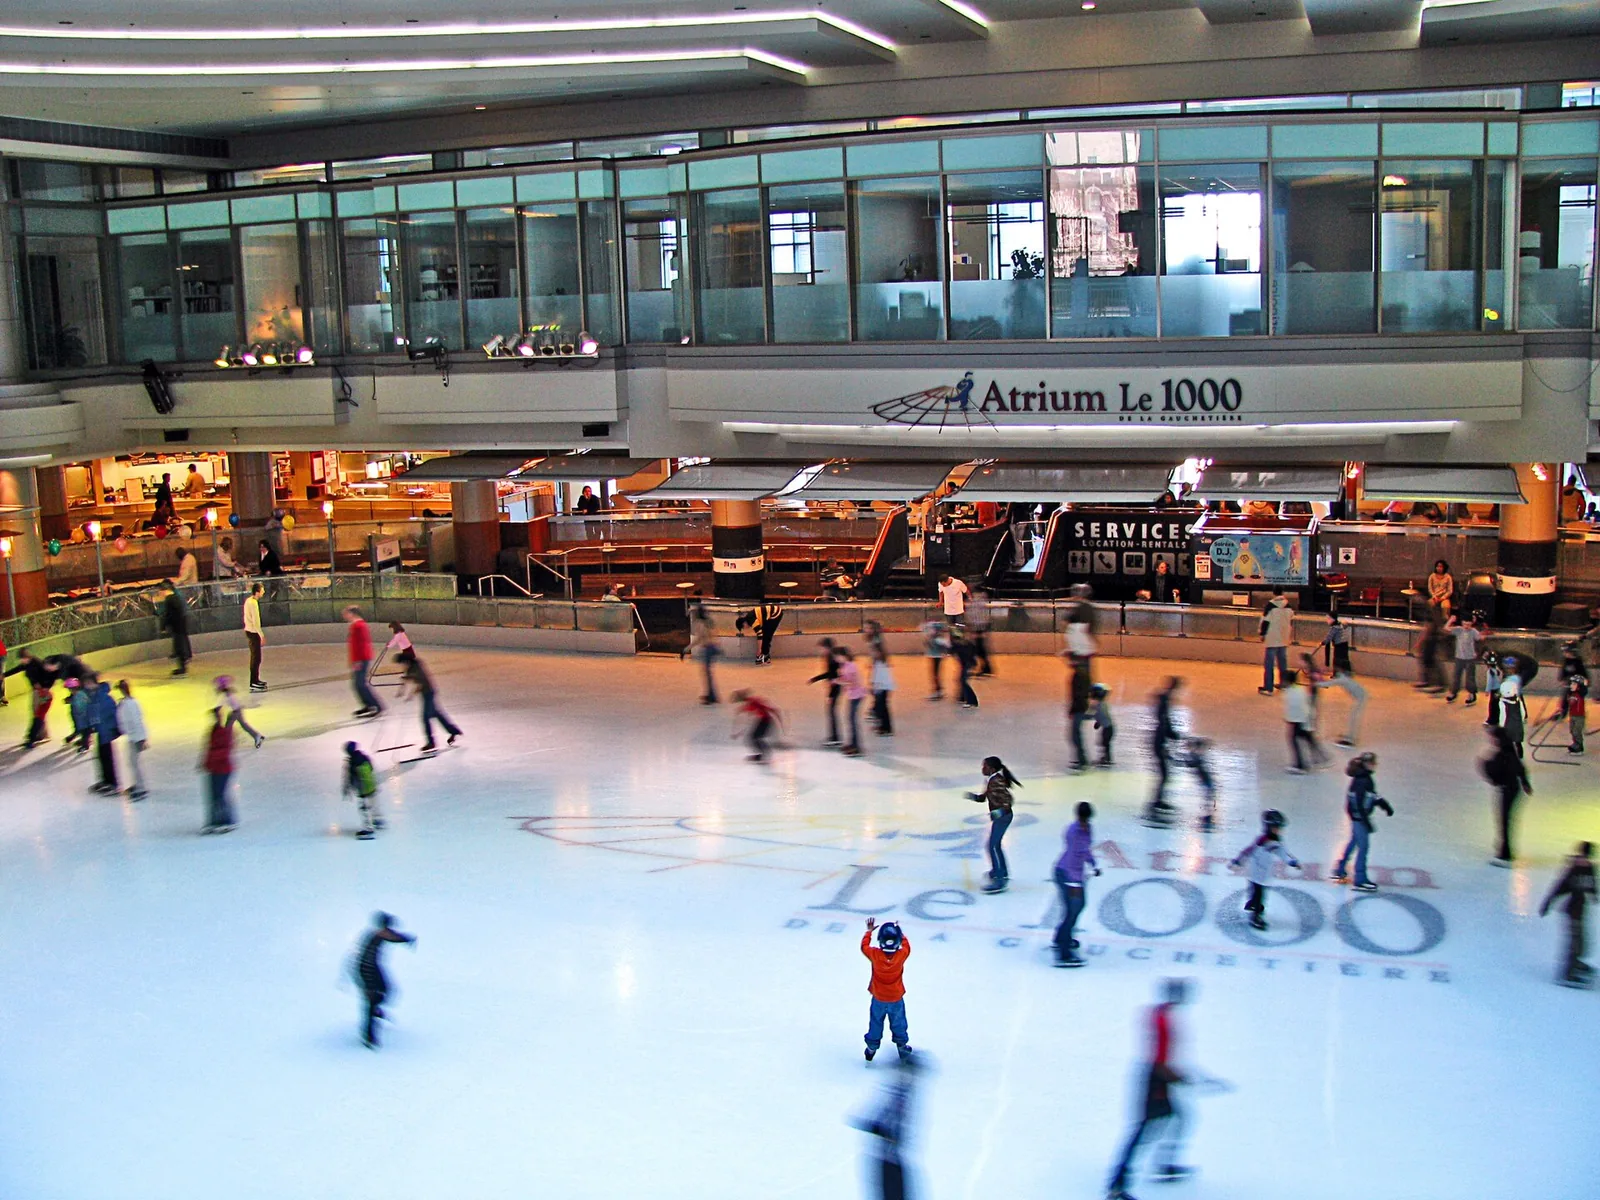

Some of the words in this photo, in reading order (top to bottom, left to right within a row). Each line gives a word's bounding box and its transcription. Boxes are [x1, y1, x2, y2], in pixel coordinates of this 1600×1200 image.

[980, 380, 1107, 412] Atrium
[1119, 383, 1152, 412] Le
[1161, 378, 1243, 412] 1000
[1074, 522, 1194, 540] SERVICES
[806, 863, 977, 921] Le
